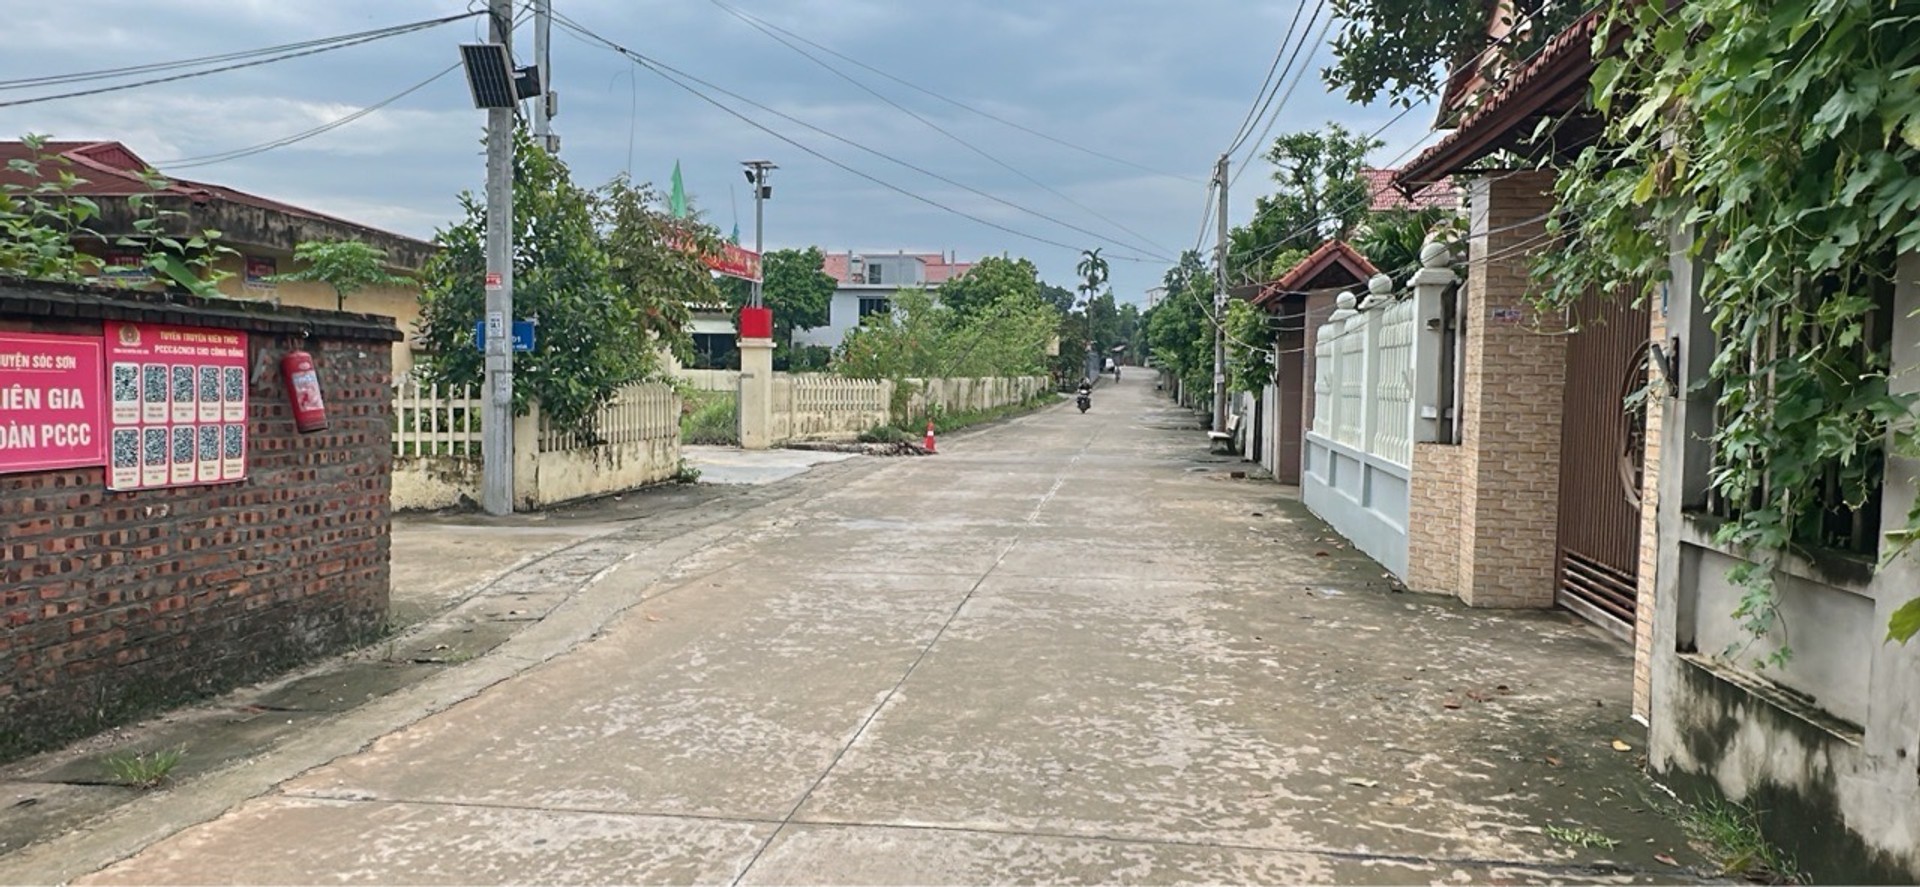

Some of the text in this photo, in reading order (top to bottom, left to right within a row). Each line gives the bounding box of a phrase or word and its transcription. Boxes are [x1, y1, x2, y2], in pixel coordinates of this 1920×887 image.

[0, 352, 76, 371] UYỆN SÓC SƠN
[0, 383, 85, 410] IÊN GIA
[41, 423, 91, 449] PCCC
